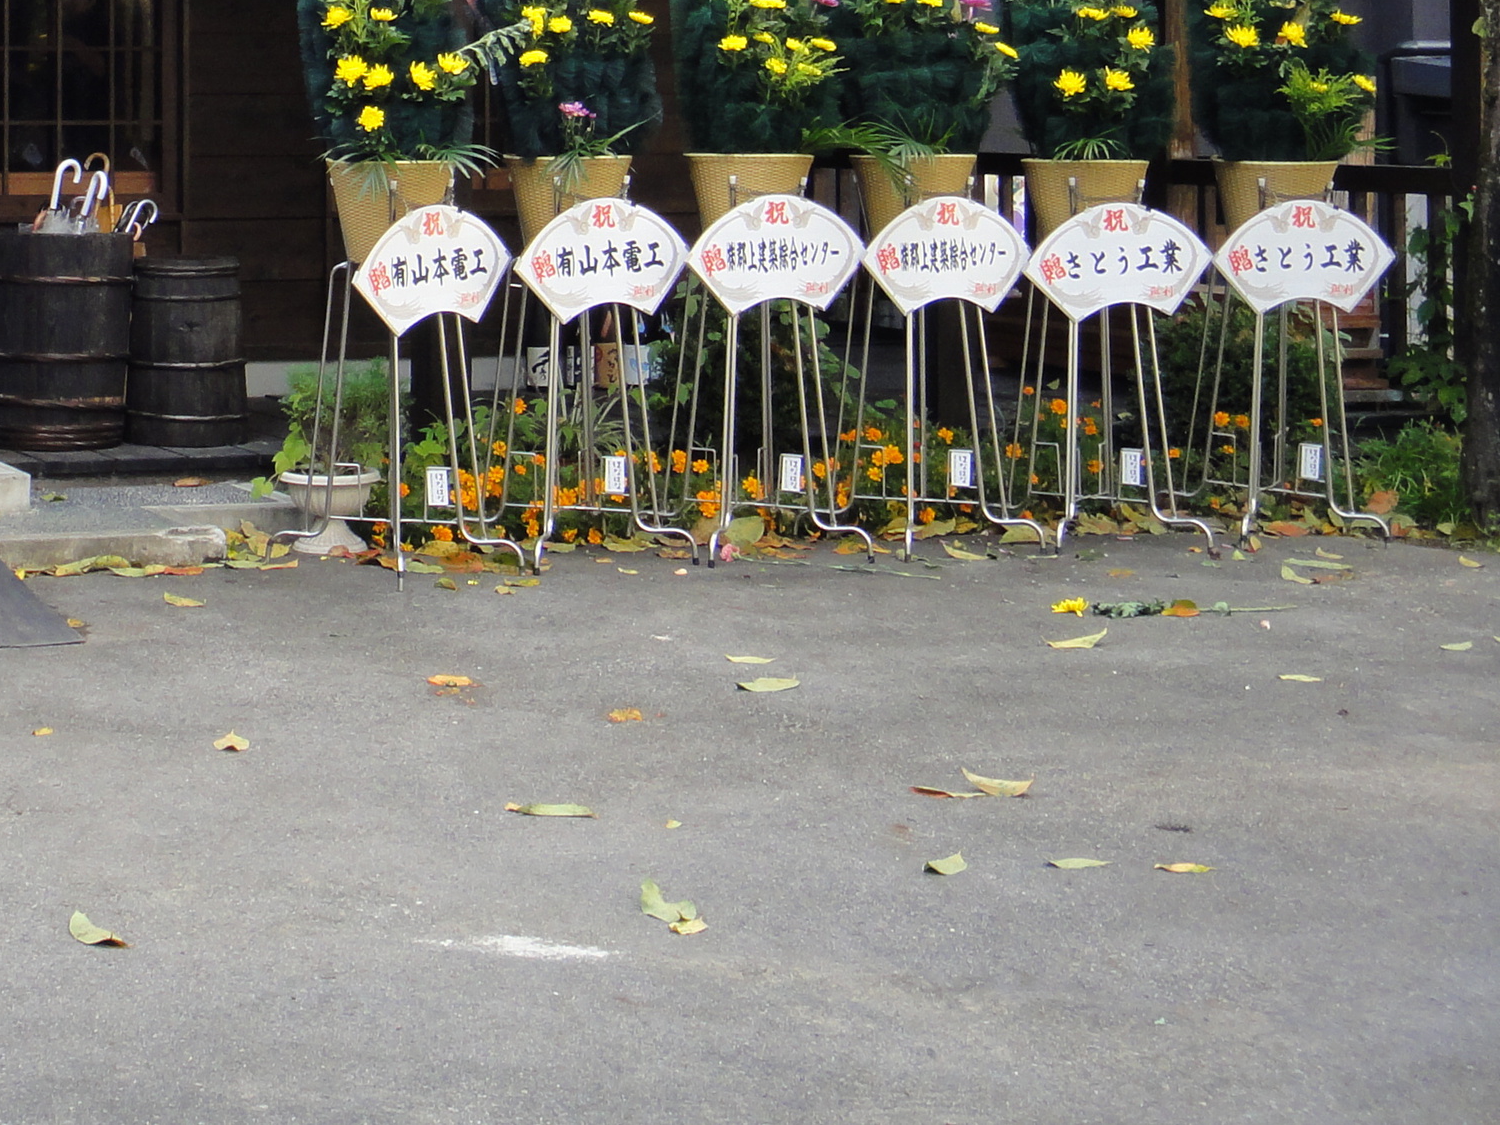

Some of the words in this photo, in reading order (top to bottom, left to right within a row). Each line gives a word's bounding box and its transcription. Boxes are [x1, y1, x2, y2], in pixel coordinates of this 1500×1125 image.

[423, 212, 444, 236] 祝
[592, 204, 616, 228] 祝
[765, 201, 790, 225] 祝
[936, 202, 960, 226] 祝
[1103, 209, 1130, 232] 祝
[1292, 205, 1316, 228] 祝
[1066, 239, 1183, 279] さとう工業
[1254, 239, 1365, 273] さとう工業
